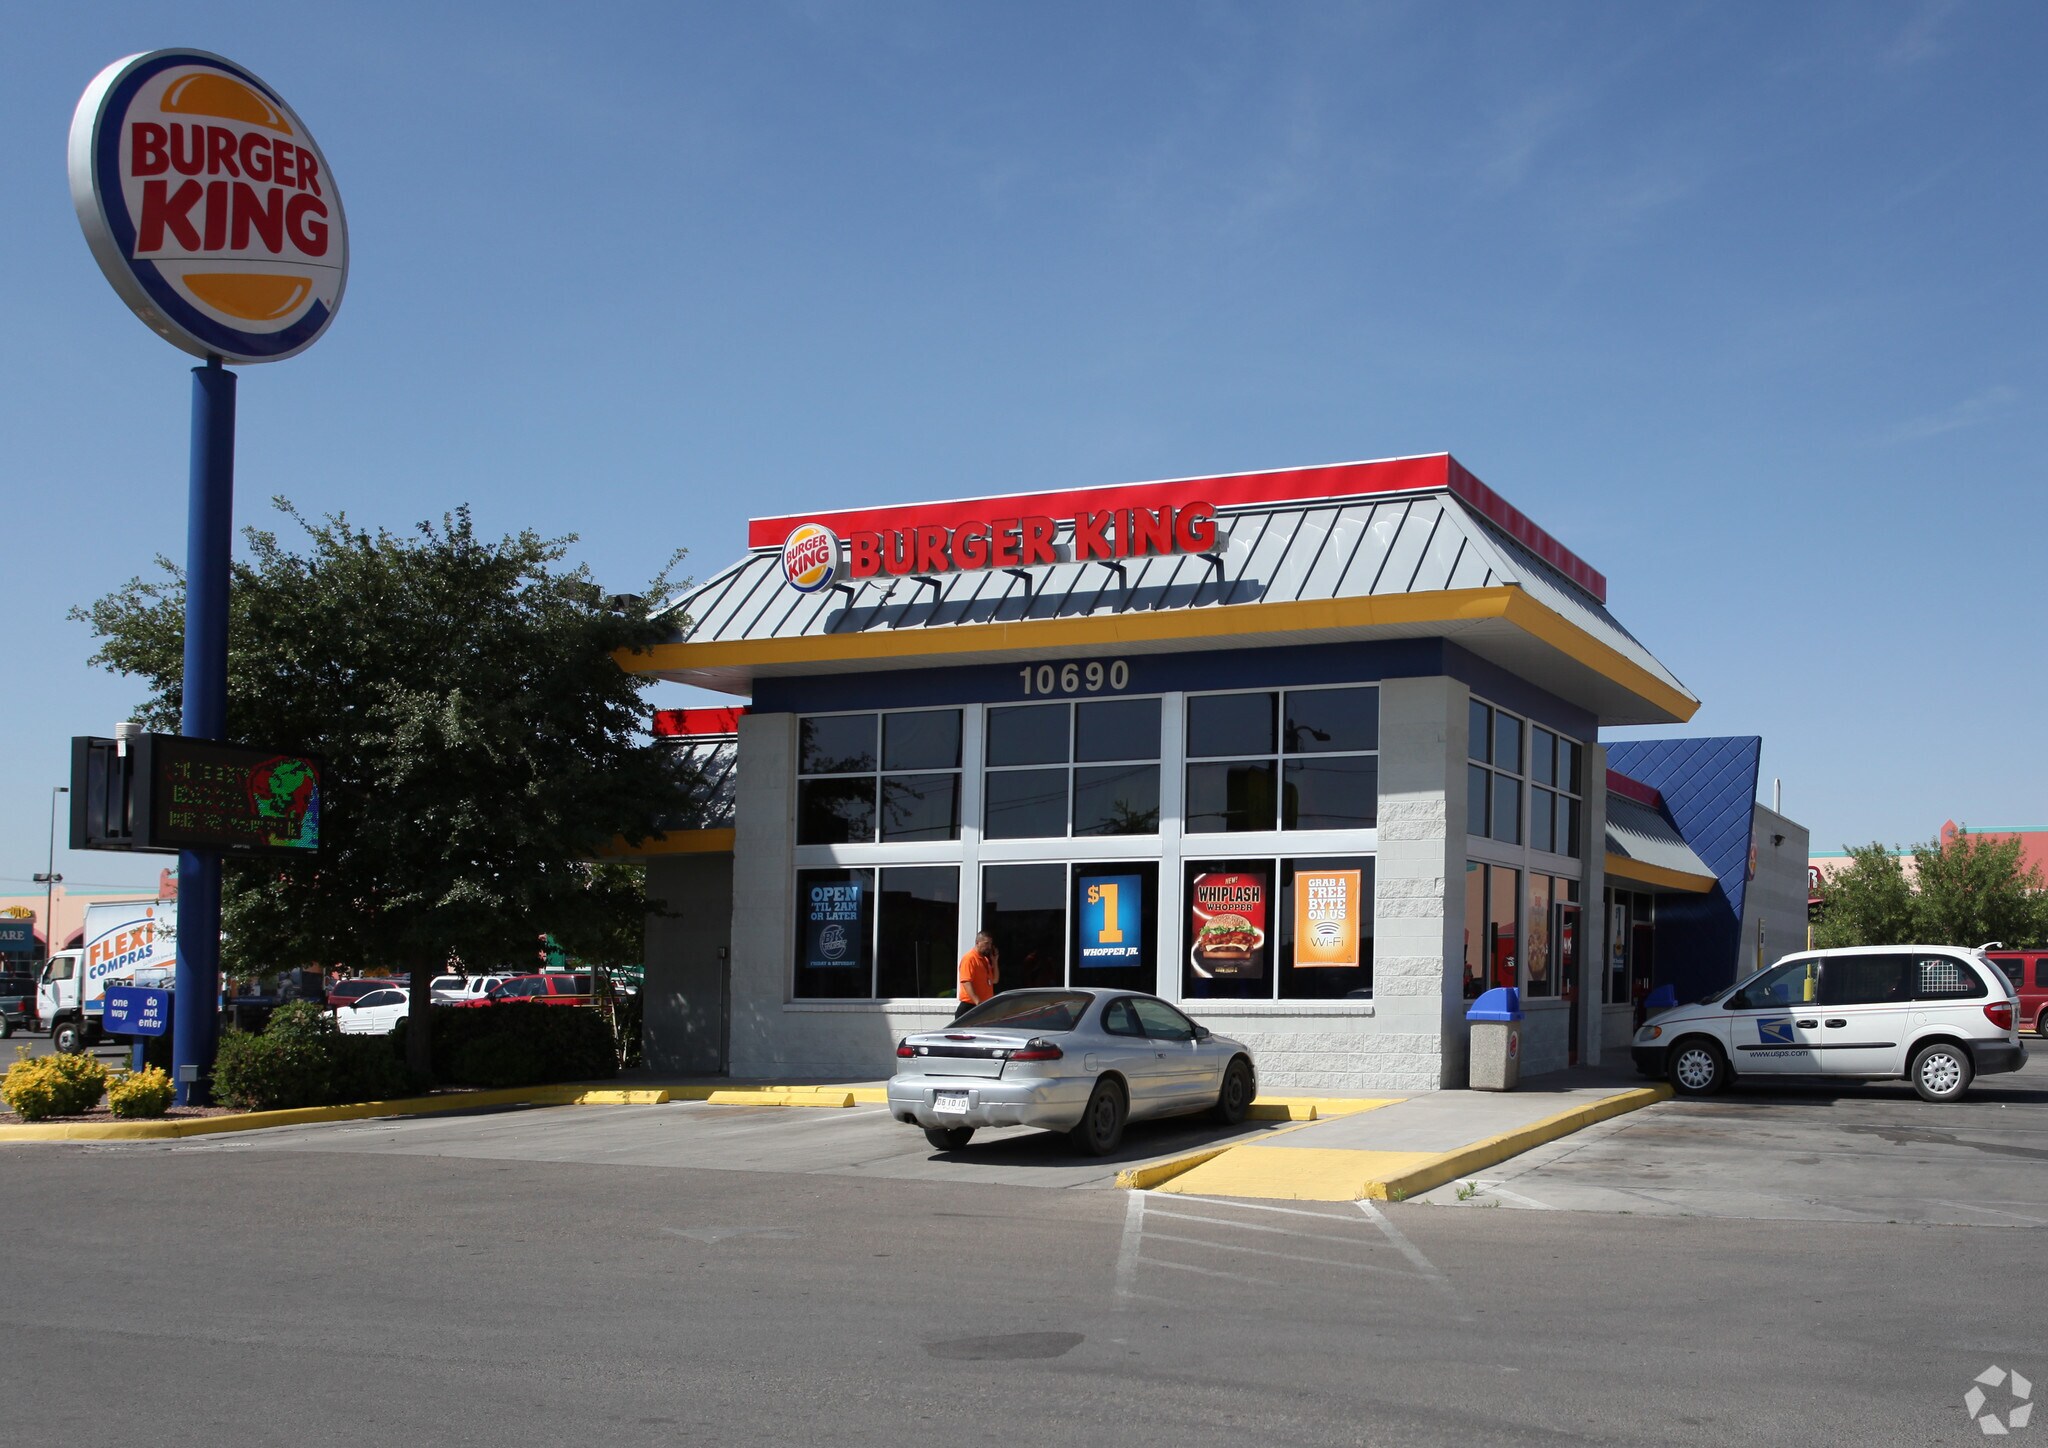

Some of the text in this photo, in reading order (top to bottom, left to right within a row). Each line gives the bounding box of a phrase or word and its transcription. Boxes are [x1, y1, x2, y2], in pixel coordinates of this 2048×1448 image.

[131, 121, 322, 197] BURGER
[137, 178, 328, 258] KING
[849, 500, 1219, 579] BURGER KING
[786, 534, 827, 566] BURGER
[788, 545, 830, 582] KING
[1019, 659, 1130, 695] 10690
[1308, 878, 1346, 887] GRAB A
[811, 886, 858, 901] OPEN
[1198, 885, 1261, 903] WHIPLASH
[1308, 886, 1346, 898] FREE
[811, 901, 857, 911] 'TIL 2AM
[1206, 903, 1254, 911] WHOPPER
[1308, 898, 1346, 910] BYTE
[810, 911, 857, 920] OR LATER
[1087, 883, 1123, 943] $1
[1308, 909, 1346, 920] ON US
[0, 930, 25, 941] ARE
[1310, 936, 1344, 947] Wi-Fi
[1083, 947, 1138, 957] WHOPPER JR.
[89, 944, 154, 980] COMPRAS
[112, 999, 129, 1007] one
[146, 996, 158, 1007] do
[111, 1009, 129, 1020] way
[143, 1007, 158, 1017] not
[138, 1018, 162, 1029] enter
[1749, 1050, 1809, 1059] www.usps.com
